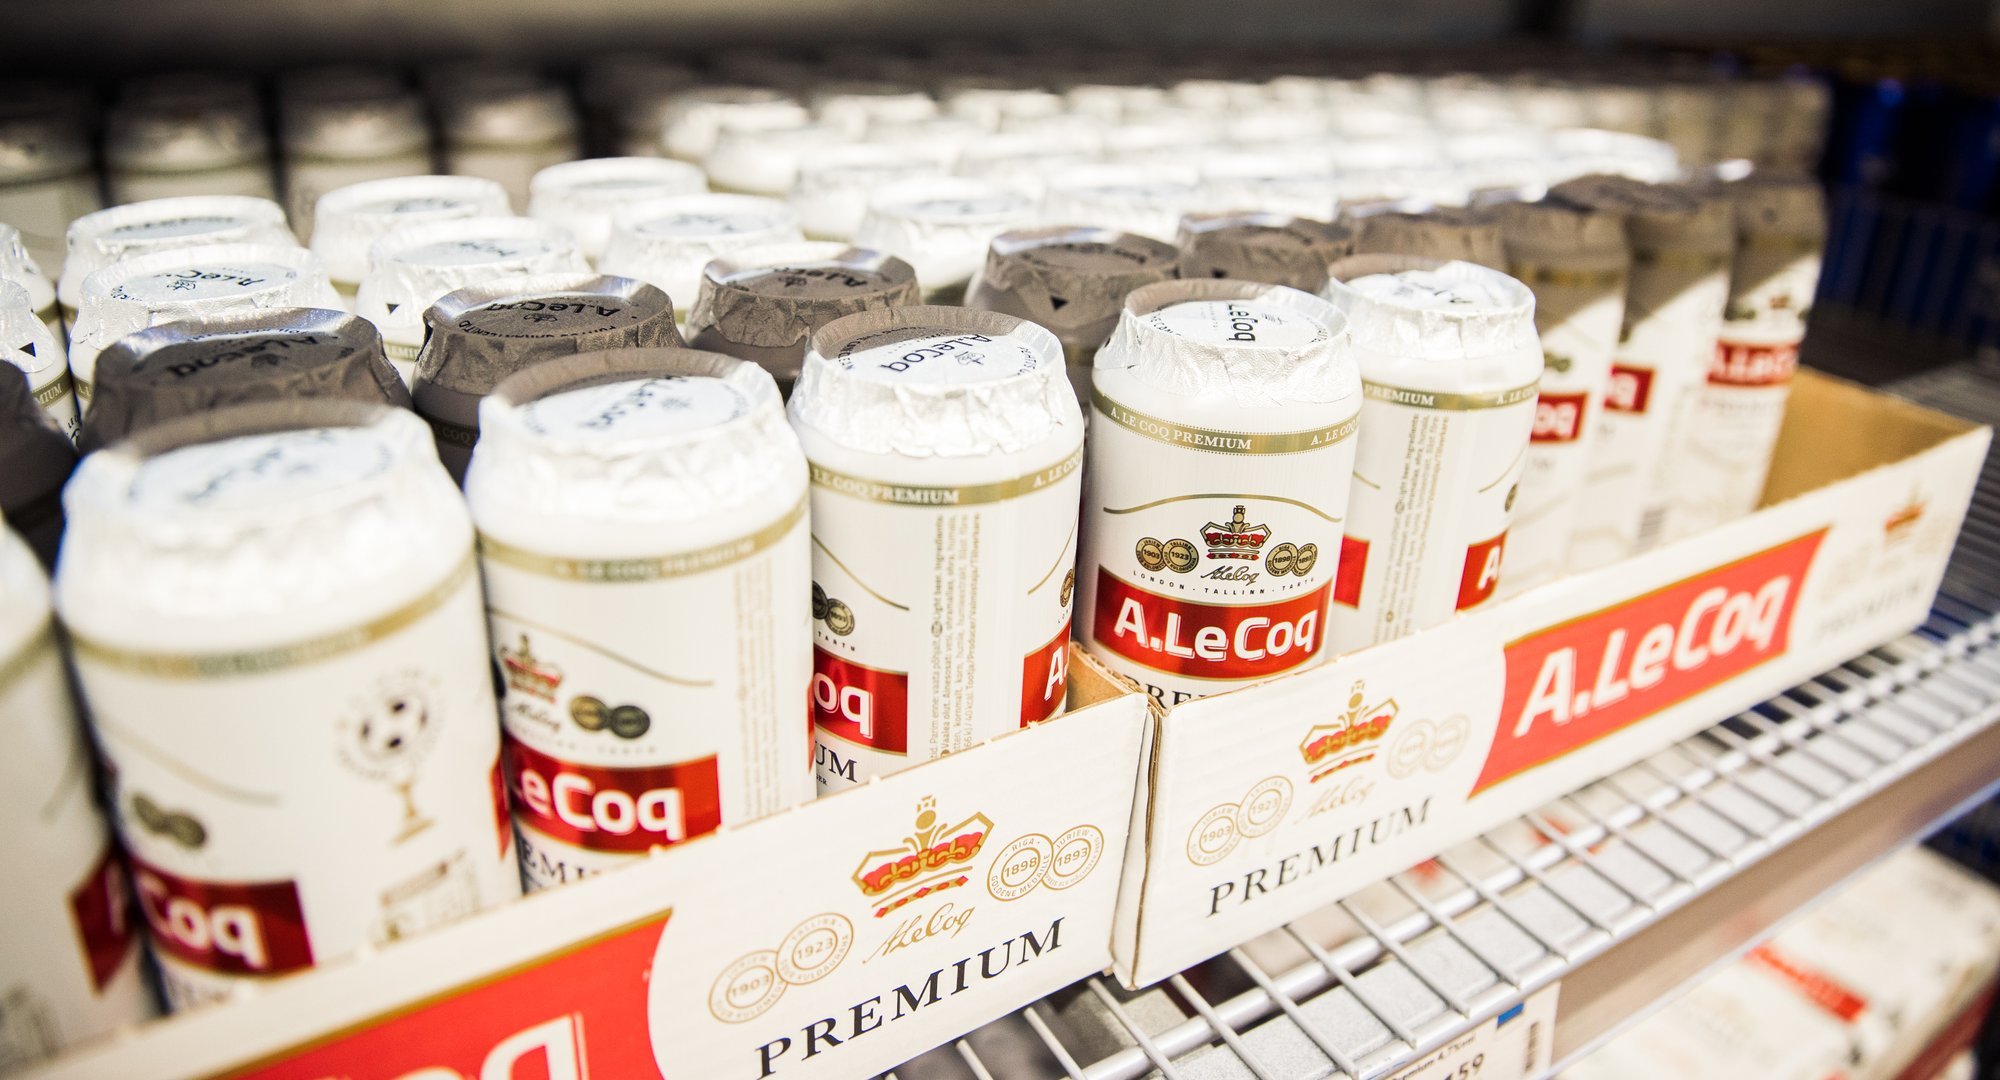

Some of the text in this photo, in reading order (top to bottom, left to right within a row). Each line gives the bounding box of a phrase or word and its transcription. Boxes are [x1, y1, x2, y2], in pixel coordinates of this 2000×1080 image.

[880, 333, 992, 373] A.LeCoq
[1365, 384, 1434, 406] PREMIUM
[1110, 407, 1252, 450] A. LE COQ PREMIUM
[1311, 434, 1322, 445] A.
[1325, 426, 1339, 442] LE
[1033, 475, 1046, 488] A.
[1049, 466, 1063, 481] LE
[872, 483, 958, 504] PREMIUM
[1171, 550, 1190, 561] 1923
[1274, 554, 1291, 565] 1898
[1133, 571, 1315, 595] LONDON TALLINN TARTU
[817, 630, 856, 652] TARTU
[1114, 597, 1318, 662] A.LeCoq
[1513, 574, 1792, 738] A.LeCoq
[814, 672, 873, 740] oq
[517, 768, 687, 842] eCoq
[1251, 798, 1277, 816] 1923
[1011, 838, 1035, 852] RIGA
[1202, 825, 1232, 844] 1903
[1004, 856, 1038, 878] 1898
[1056, 847, 1089, 867] 1893
[1206, 797, 1433, 919] PREMIUM
[991, 853, 1051, 898] GOLDENE MEDAILLE
[136, 871, 267, 969] Coq
[797, 937, 834, 960] 1923
[731, 973, 770, 997] 1903
[755, 917, 1065, 1080] PREMIUM
